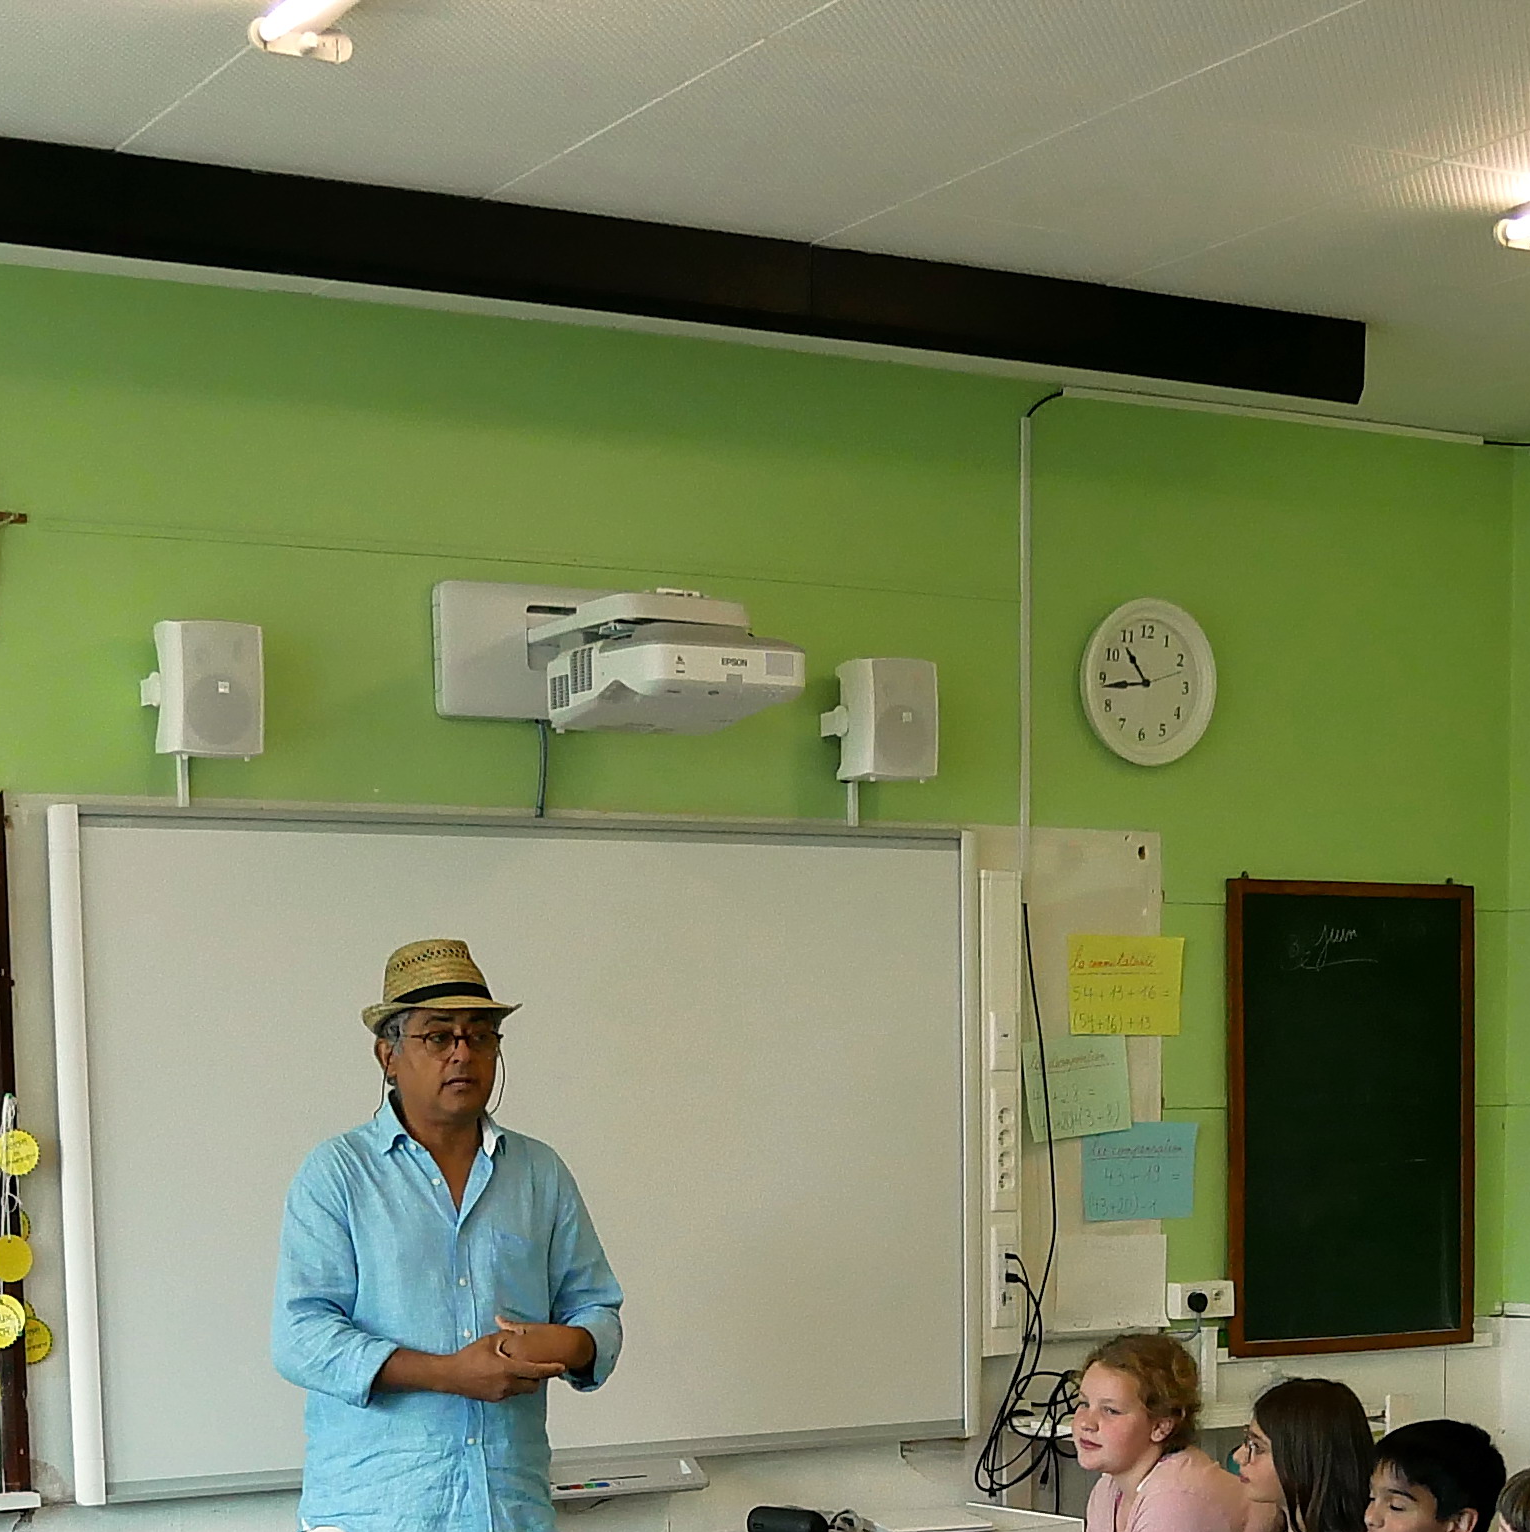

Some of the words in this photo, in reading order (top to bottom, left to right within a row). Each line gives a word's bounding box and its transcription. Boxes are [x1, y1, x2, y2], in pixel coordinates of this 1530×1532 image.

[1121, 630, 1134, 643] 11
[1140, 625, 1155, 639] 12
[1164, 635, 1169, 648] 1
[1106, 648, 1120, 662] 10
[1176, 653, 1184, 667] 2
[1099, 672, 1107, 683] 9
[1182, 681, 1189, 695] 3
[1104, 699, 1112, 712] 8
[1174, 706, 1181, 719] 4
[1119, 718, 1126, 730] 7
[1159, 723, 1166, 737] 5
[1138, 728, 1146, 741] 6
